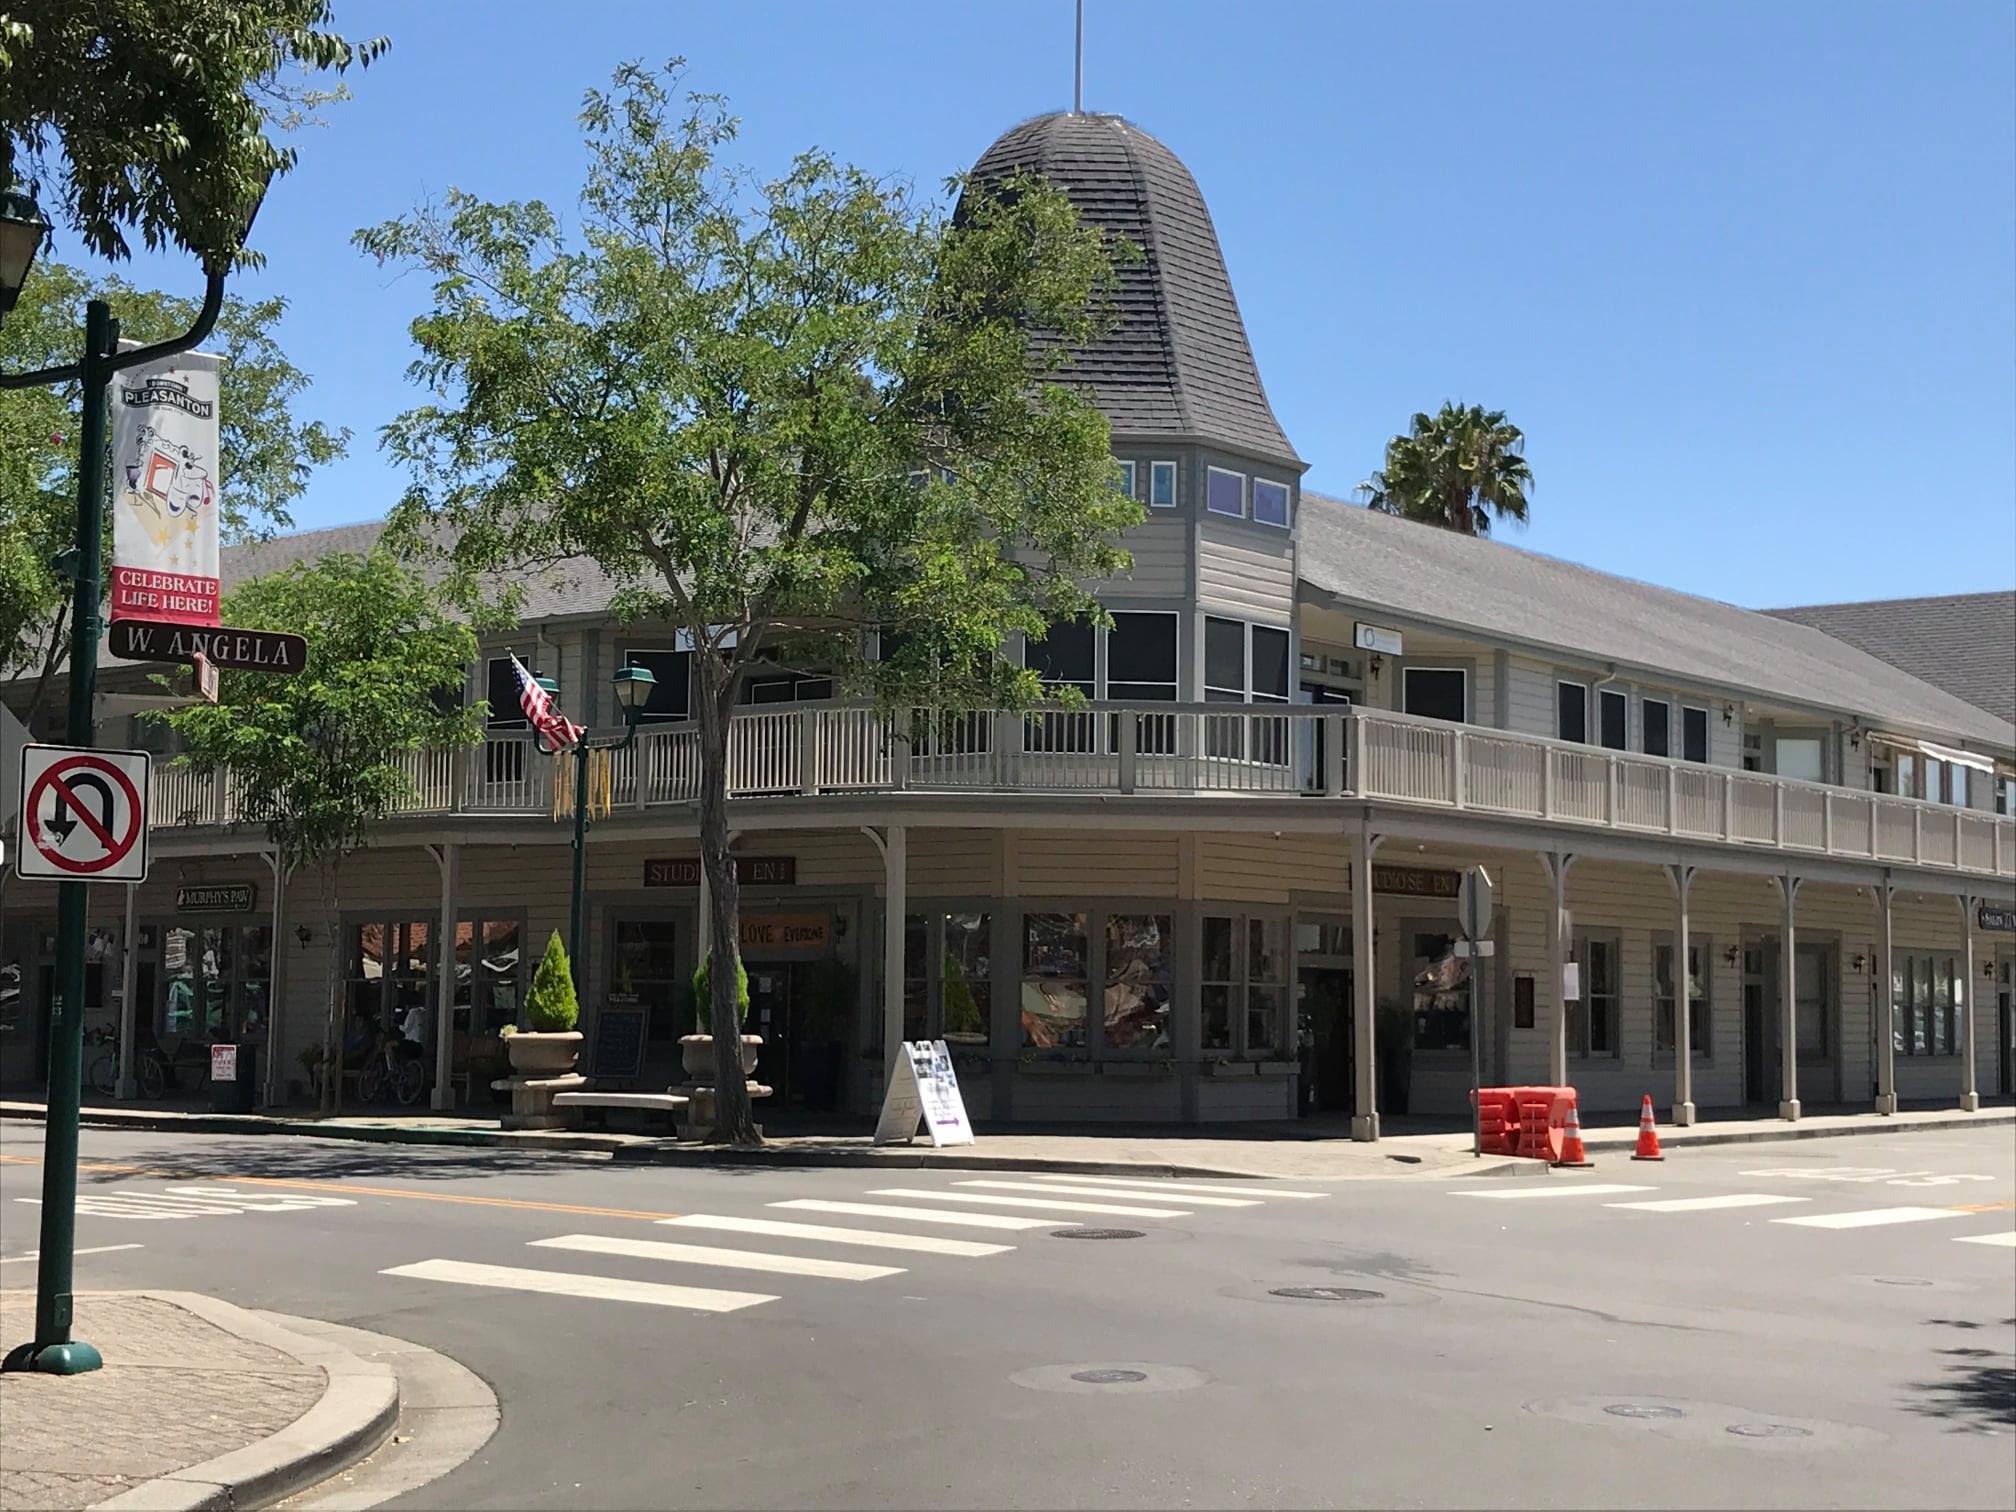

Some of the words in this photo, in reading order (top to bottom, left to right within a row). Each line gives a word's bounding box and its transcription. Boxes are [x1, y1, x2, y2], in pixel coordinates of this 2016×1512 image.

[125, 388, 210, 416] PLEASANTON
[119, 570, 217, 595] CELEBRATE
[121, 589, 159, 608] LIFE
[162, 595, 213, 614] HERE!
[127, 626, 155, 654] W.
[168, 631, 291, 666] ANGELA
[649, 863, 700, 882] STUDI
[185, 890, 229, 905] MURPHY'S
[230, 889, 249, 903] PAW
[740, 922, 774, 944] LOVE
